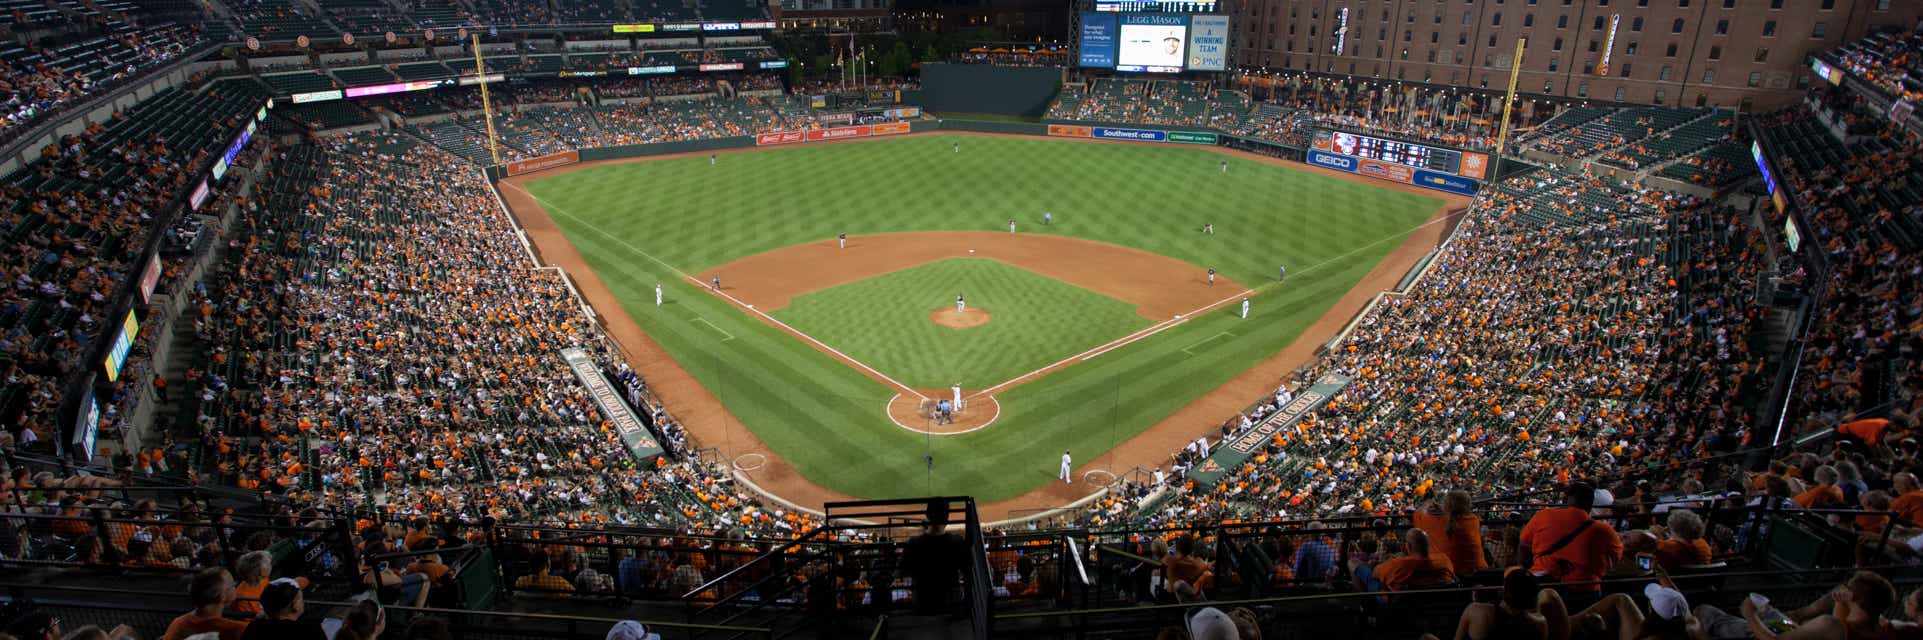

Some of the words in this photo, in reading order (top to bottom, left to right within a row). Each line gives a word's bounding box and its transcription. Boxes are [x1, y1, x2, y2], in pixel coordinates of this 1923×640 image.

[1127, 15, 1150, 24] LEGG
[1150, 15, 1182, 25] MASON
[1199, 45, 1217, 53] TEAM
[1203, 56, 1222, 66] PNC
[1316, 154, 1350, 167] GEICO
